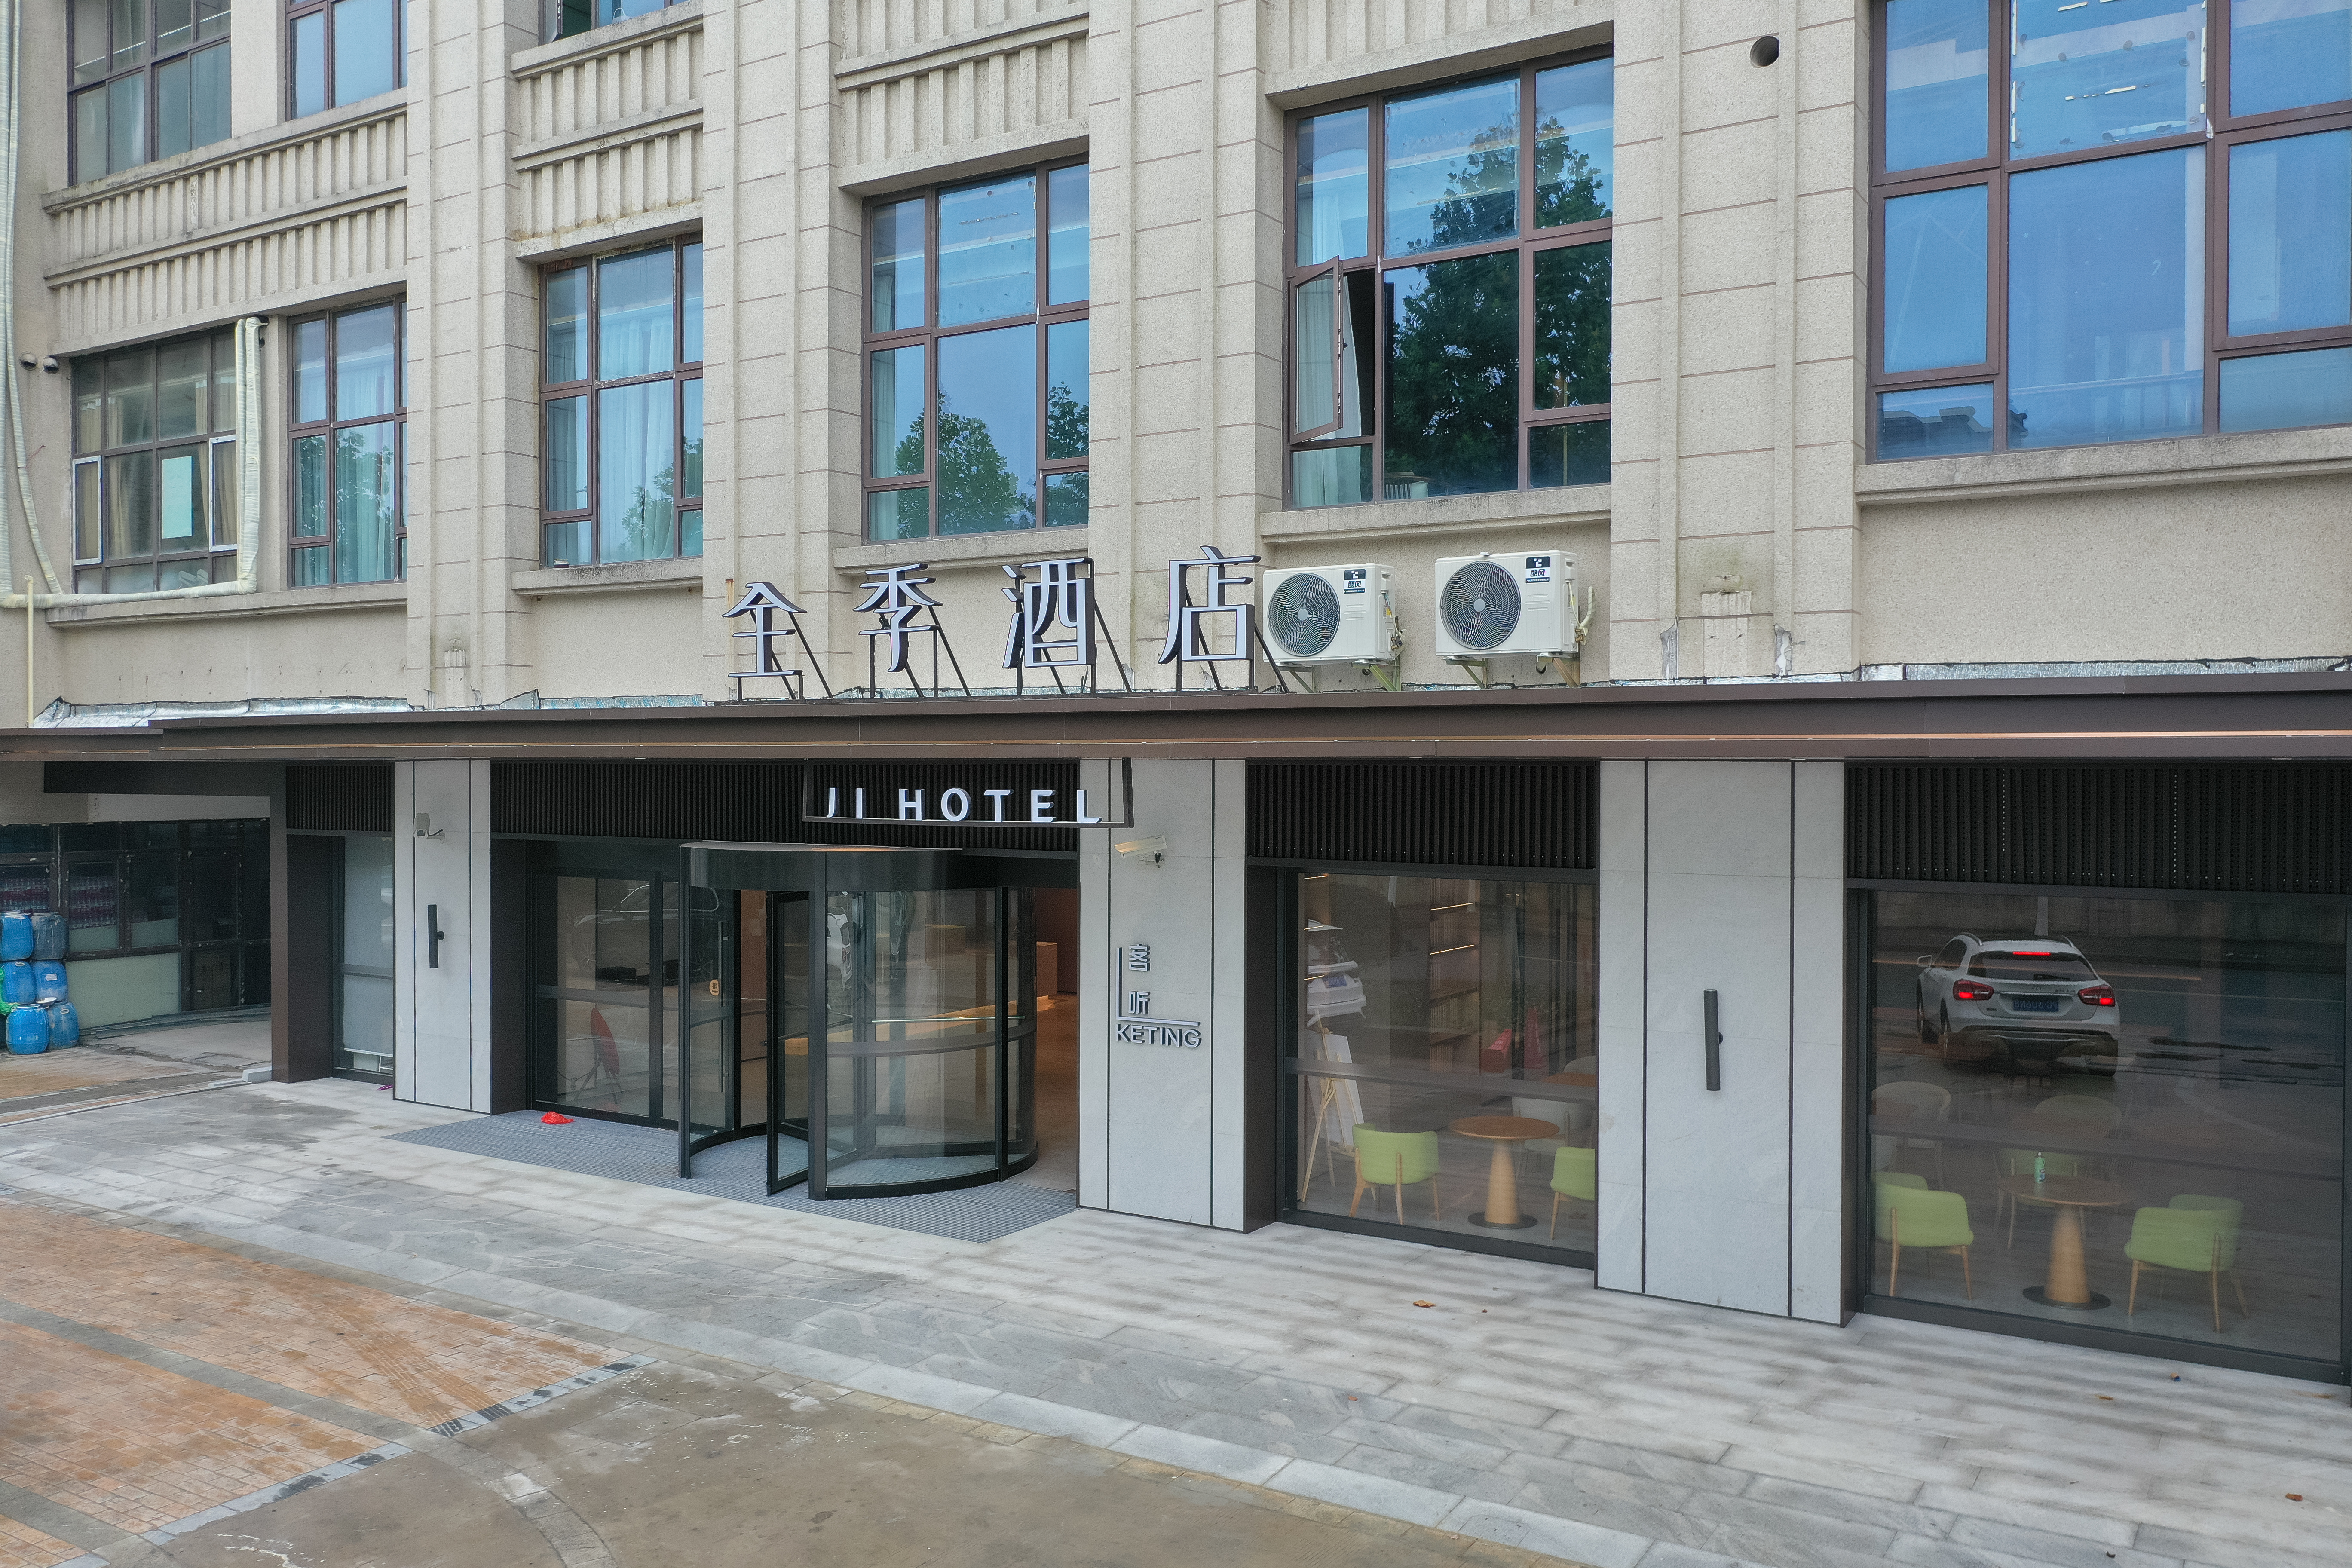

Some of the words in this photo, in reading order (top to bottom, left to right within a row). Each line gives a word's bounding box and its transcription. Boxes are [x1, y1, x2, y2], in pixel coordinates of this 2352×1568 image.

[722, 545, 1262, 678] 全季酒店
[826, 787, 866, 819] JI
[899, 788, 1102, 823] HOTEL
[1128, 943, 1151, 1015] 客听
[1115, 1023, 1202, 1048] KETING
